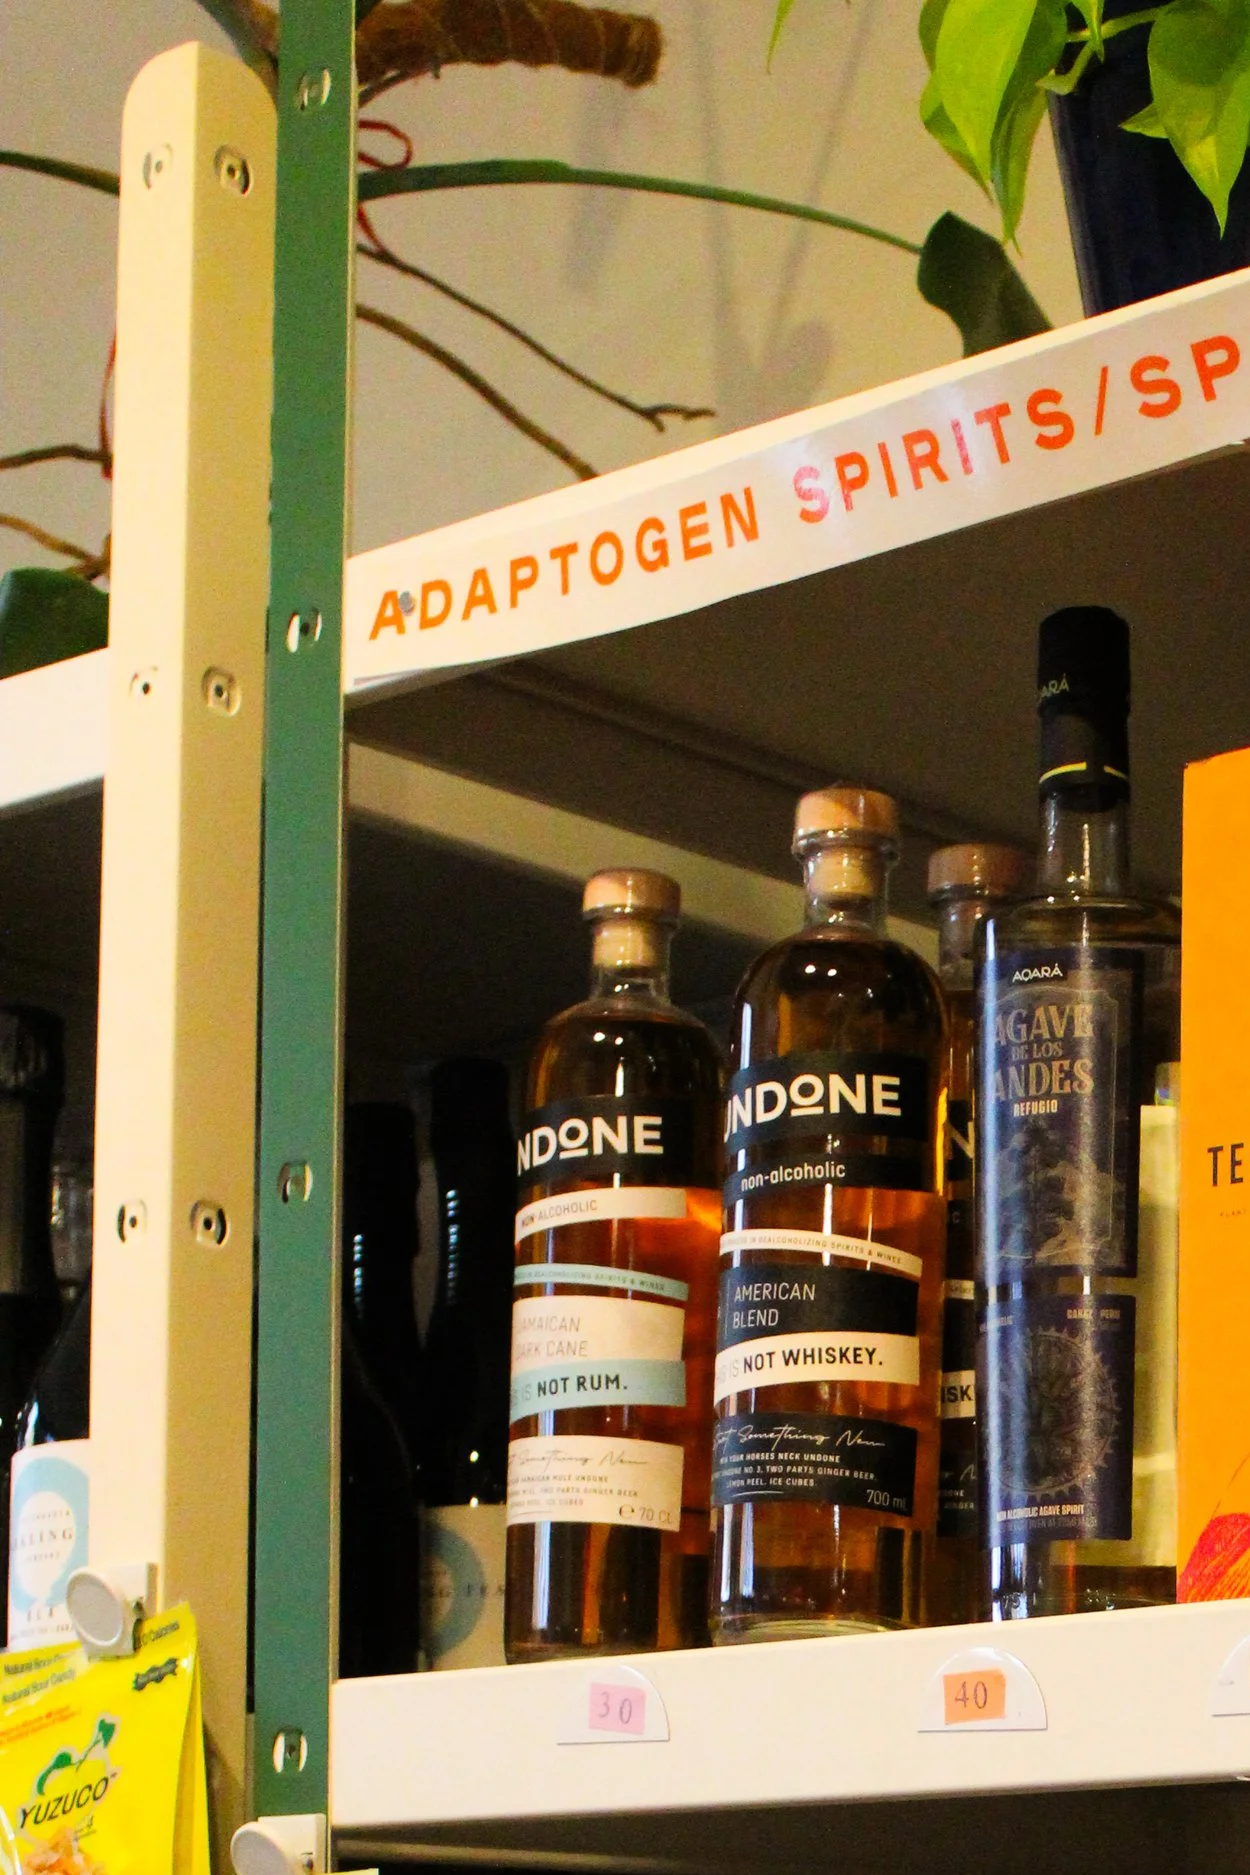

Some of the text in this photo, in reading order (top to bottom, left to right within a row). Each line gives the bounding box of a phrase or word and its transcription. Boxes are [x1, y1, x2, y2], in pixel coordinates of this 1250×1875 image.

[369, 485, 761, 641] ADAPTOGEN
[1011, 1041, 1063, 1061] DE LOS
[994, 1059, 1095, 1100] ANDES
[1013, 1099, 1058, 1117] REFUGIO
[741, 1161, 846, 1192] non-alcoholic
[734, 1282, 816, 1301] AMERICAN
[733, 1308, 779, 1329] BLEND
[547, 1341, 588, 1357] CANE
[743, 1347, 884, 1374] NOT WHISKEY.
[538, 1377, 569, 1396] NOT
[576, 1375, 628, 1393] RUM.
[804, 1454, 841, 1463] UNDONE
[866, 1490, 890, 1506] 700
[640, 1507, 653, 1521] 70
[1040, 1504, 1084, 1516] AGAVE SPIRIT
[953, 1680, 990, 1710] 40
[597, 1689, 635, 1728] 30
[20, 1775, 109, 1829] YUZUCO
